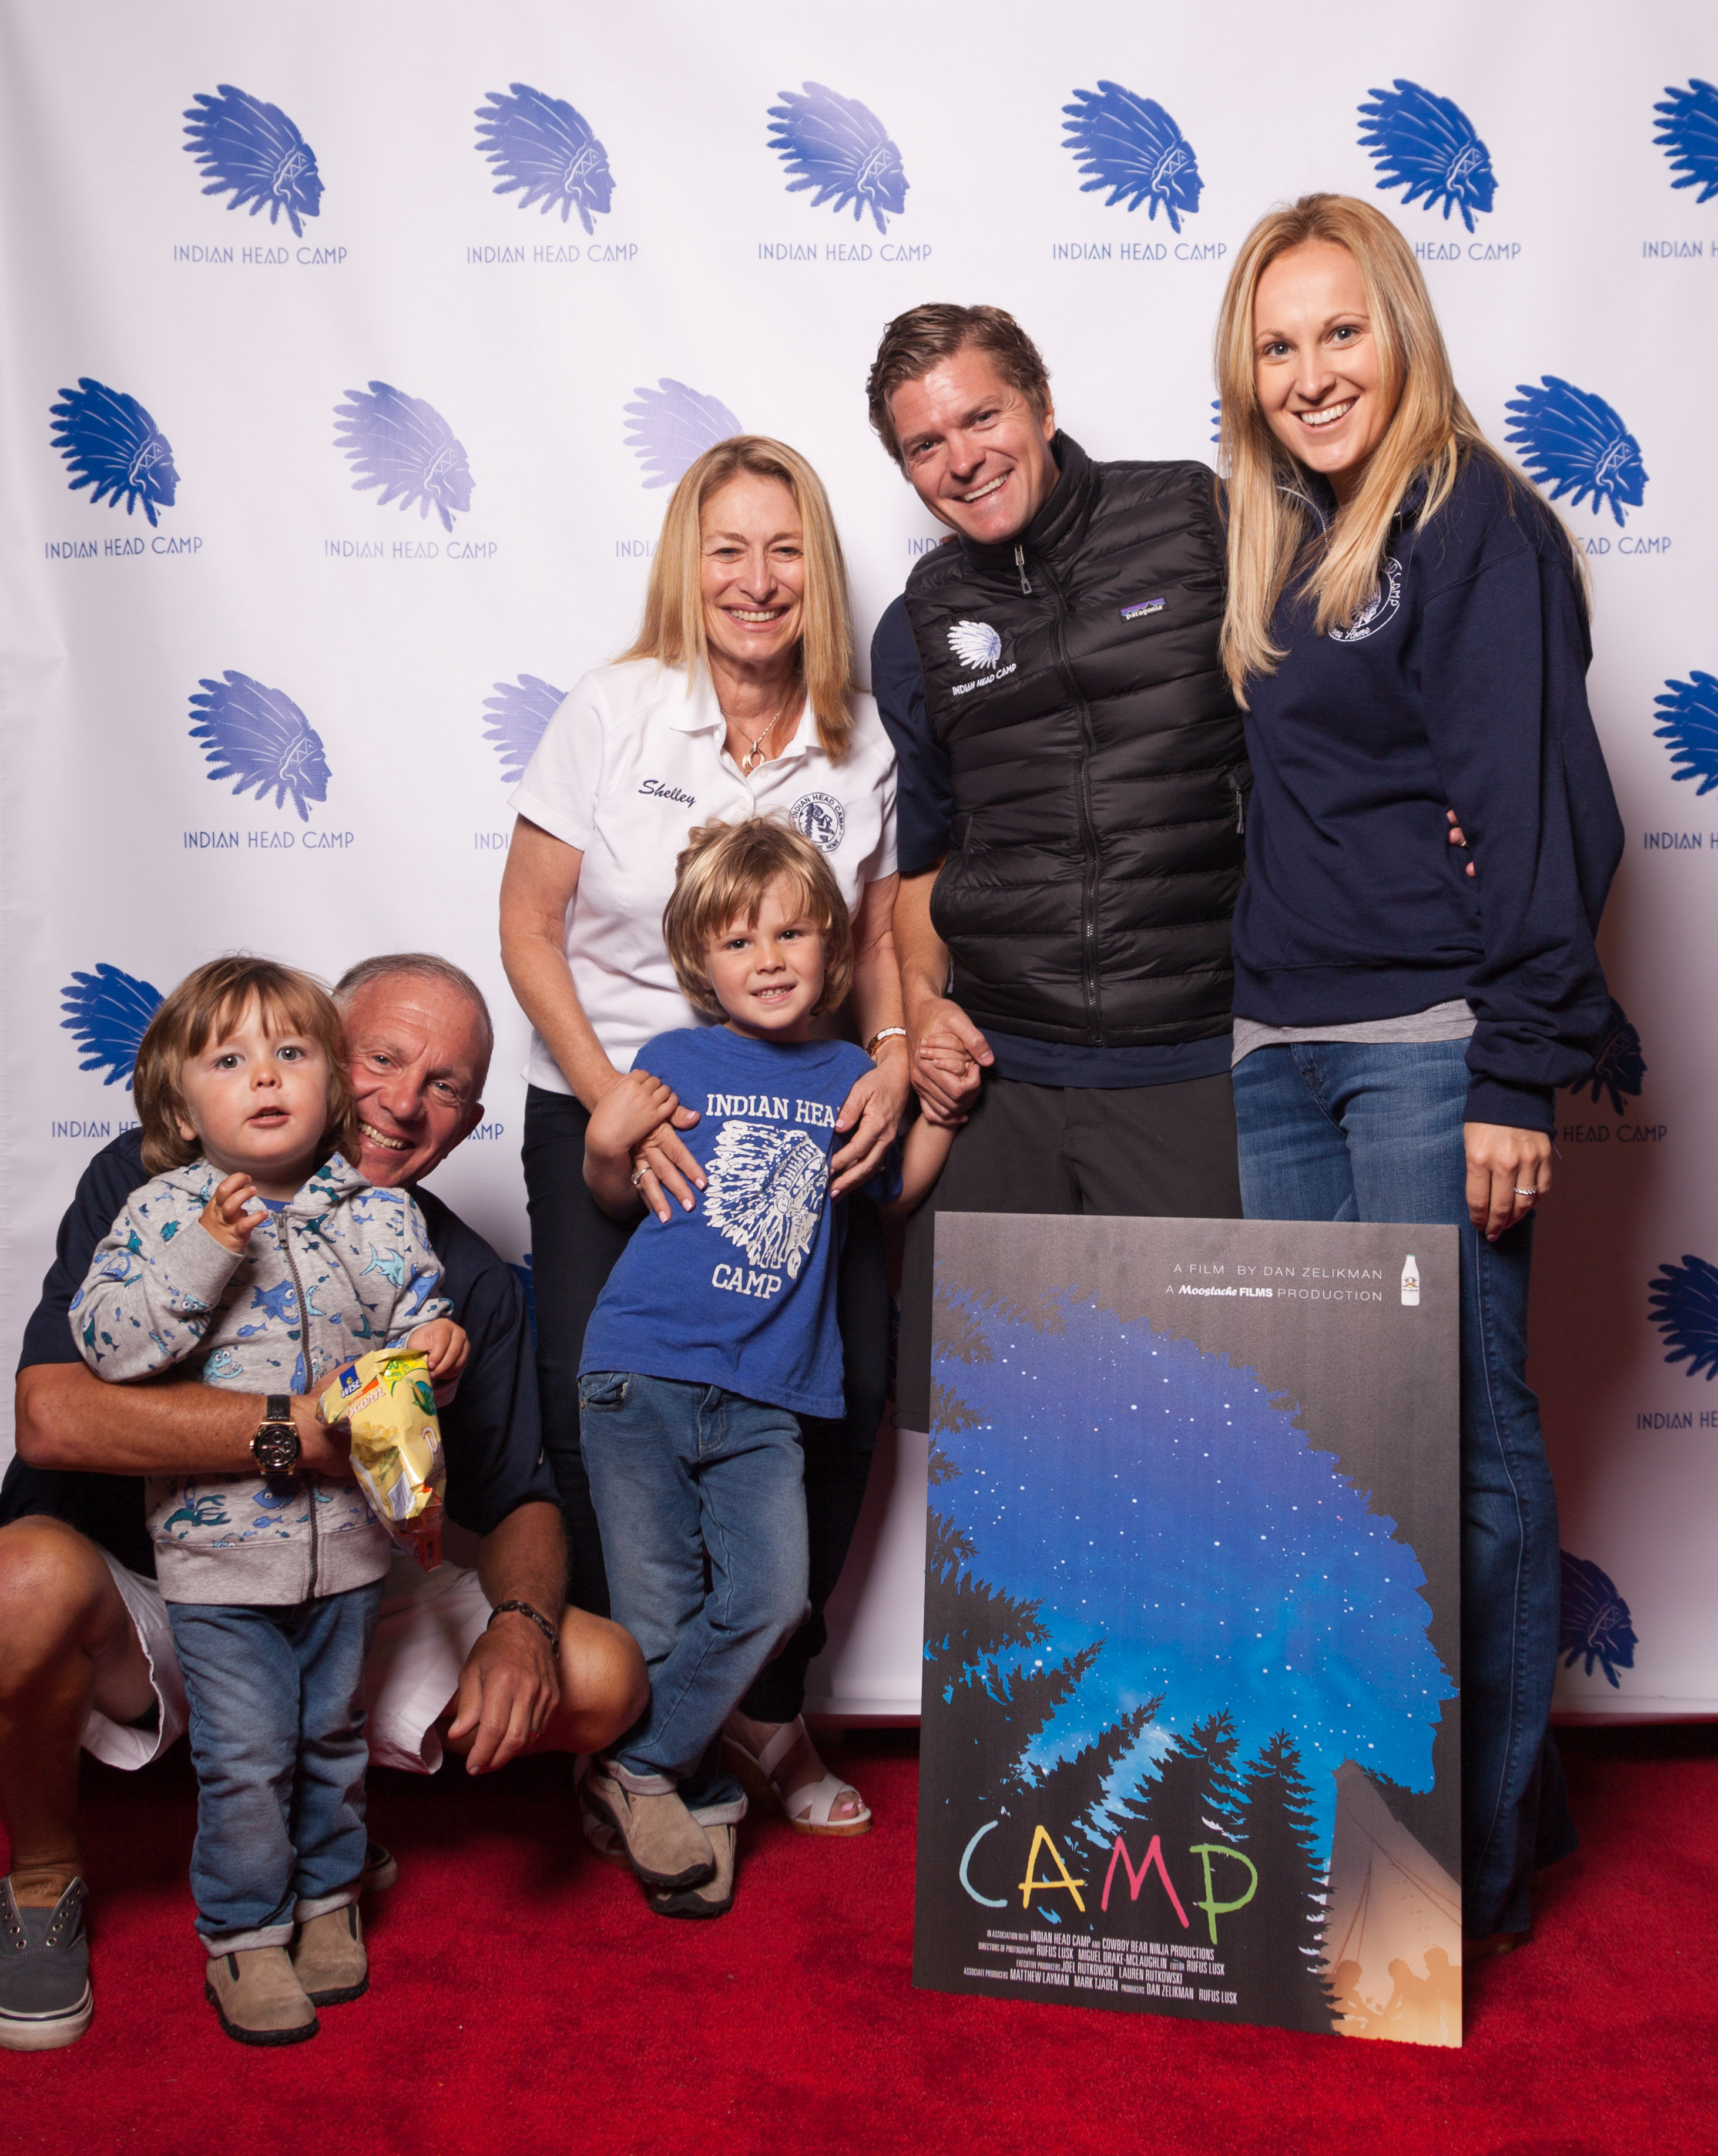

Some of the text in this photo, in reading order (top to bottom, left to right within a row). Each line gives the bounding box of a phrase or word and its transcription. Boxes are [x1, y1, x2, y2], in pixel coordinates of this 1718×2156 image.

[174, 244, 347, 265] INDIAN HEAD CAMP
[468, 243, 637, 263] INDIAN HEAD CAMP
[759, 243, 931, 261] INDIAN HEAD CAMP
[1053, 243, 1226, 261] INDIAN HEAD CAMP
[1415, 242, 1521, 260] HEAD CAMP
[1643, 240, 1703, 258] INDIAN
[45, 536, 203, 559] INDIAN HEAD CAMP
[325, 539, 498, 559] INDIAN HEAD CAMP
[616, 540, 657, 558] INDI
[908, 538, 942, 555] IND
[1577, 536, 1672, 555] EAD CAMP
[1391, 572, 1402, 606] CAMP
[1126, 604, 1163, 620] patagonia
[952, 663, 1017, 696] INDIAN HEAD CAMP
[638, 779, 696, 808] Shelley
[792, 794, 844, 830] INDIAN HEAD CAMP
[184, 831, 354, 849] INDIAN HEAD CAMP
[475, 832, 508, 849] INDI
[1644, 832, 1702, 849] INDIAN
[706, 1094, 839, 1128] INDIAN HEA
[52, 1121, 110, 1138] INDIAN
[468, 1123, 504, 1140] AMP
[1563, 1125, 1668, 1143] HEAD CAMP
[1173, 1264, 1383, 1279] A FILM BY DAN ZELIKMAN
[712, 1264, 783, 1299] CAMP
[1166, 1284, 1383, 1301] A Moostache FILMS PRODUCTION
[341, 1379, 361, 1398] WISE
[1637, 1411, 1718, 1430] INDIAN HE
[959, 1820, 1258, 1945] CAMP
[992, 1930, 1017, 1940] ASSOCIATION
[1018, 1932, 1029, 1942] WITH
[1031, 1930, 1052, 1945] INDIAN
[1054, 1932, 1071, 1946] HEAD
[1072, 1934, 1090, 1948] CAMP
[1092, 1940, 1100, 1949] AND
[1102, 1937, 1129, 1953] COWBOY
[1131, 1940, 1147, 1954] BEAR
[1149, 1942, 1169, 1957] NINJA
[1170, 1945, 1214, 1961] PRODUCTIONS
[978, 1942, 999, 1952] DIRECTORS
[1000, 1944, 1005, 1952] OF
[1006, 1945, 1035, 1955] PHOTOGRAPHY
[1036, 1944, 1057, 1958] RUFUS
[1058, 1946, 1073, 1960] LUSK
[1078, 1949, 1101, 1963] MIGUEL
[1170, 1962, 1185, 1972] EDITOR
[1187, 1959, 1207, 1974] RUFUS
[1209, 1962, 1225, 1976] LUSK
[1016, 1959, 1182, 1985] EXECUTIVE PRODUCERS JOEL RUTKOWSKI LAUREN RUTKOWSKI
[964, 1967, 1237, 2004] ASSOCIATE PRODUCERS MATTHEW LAYMAN MARK TJADEN PRODUCERS DAN ZELIKMAN RUFUS LUSK
